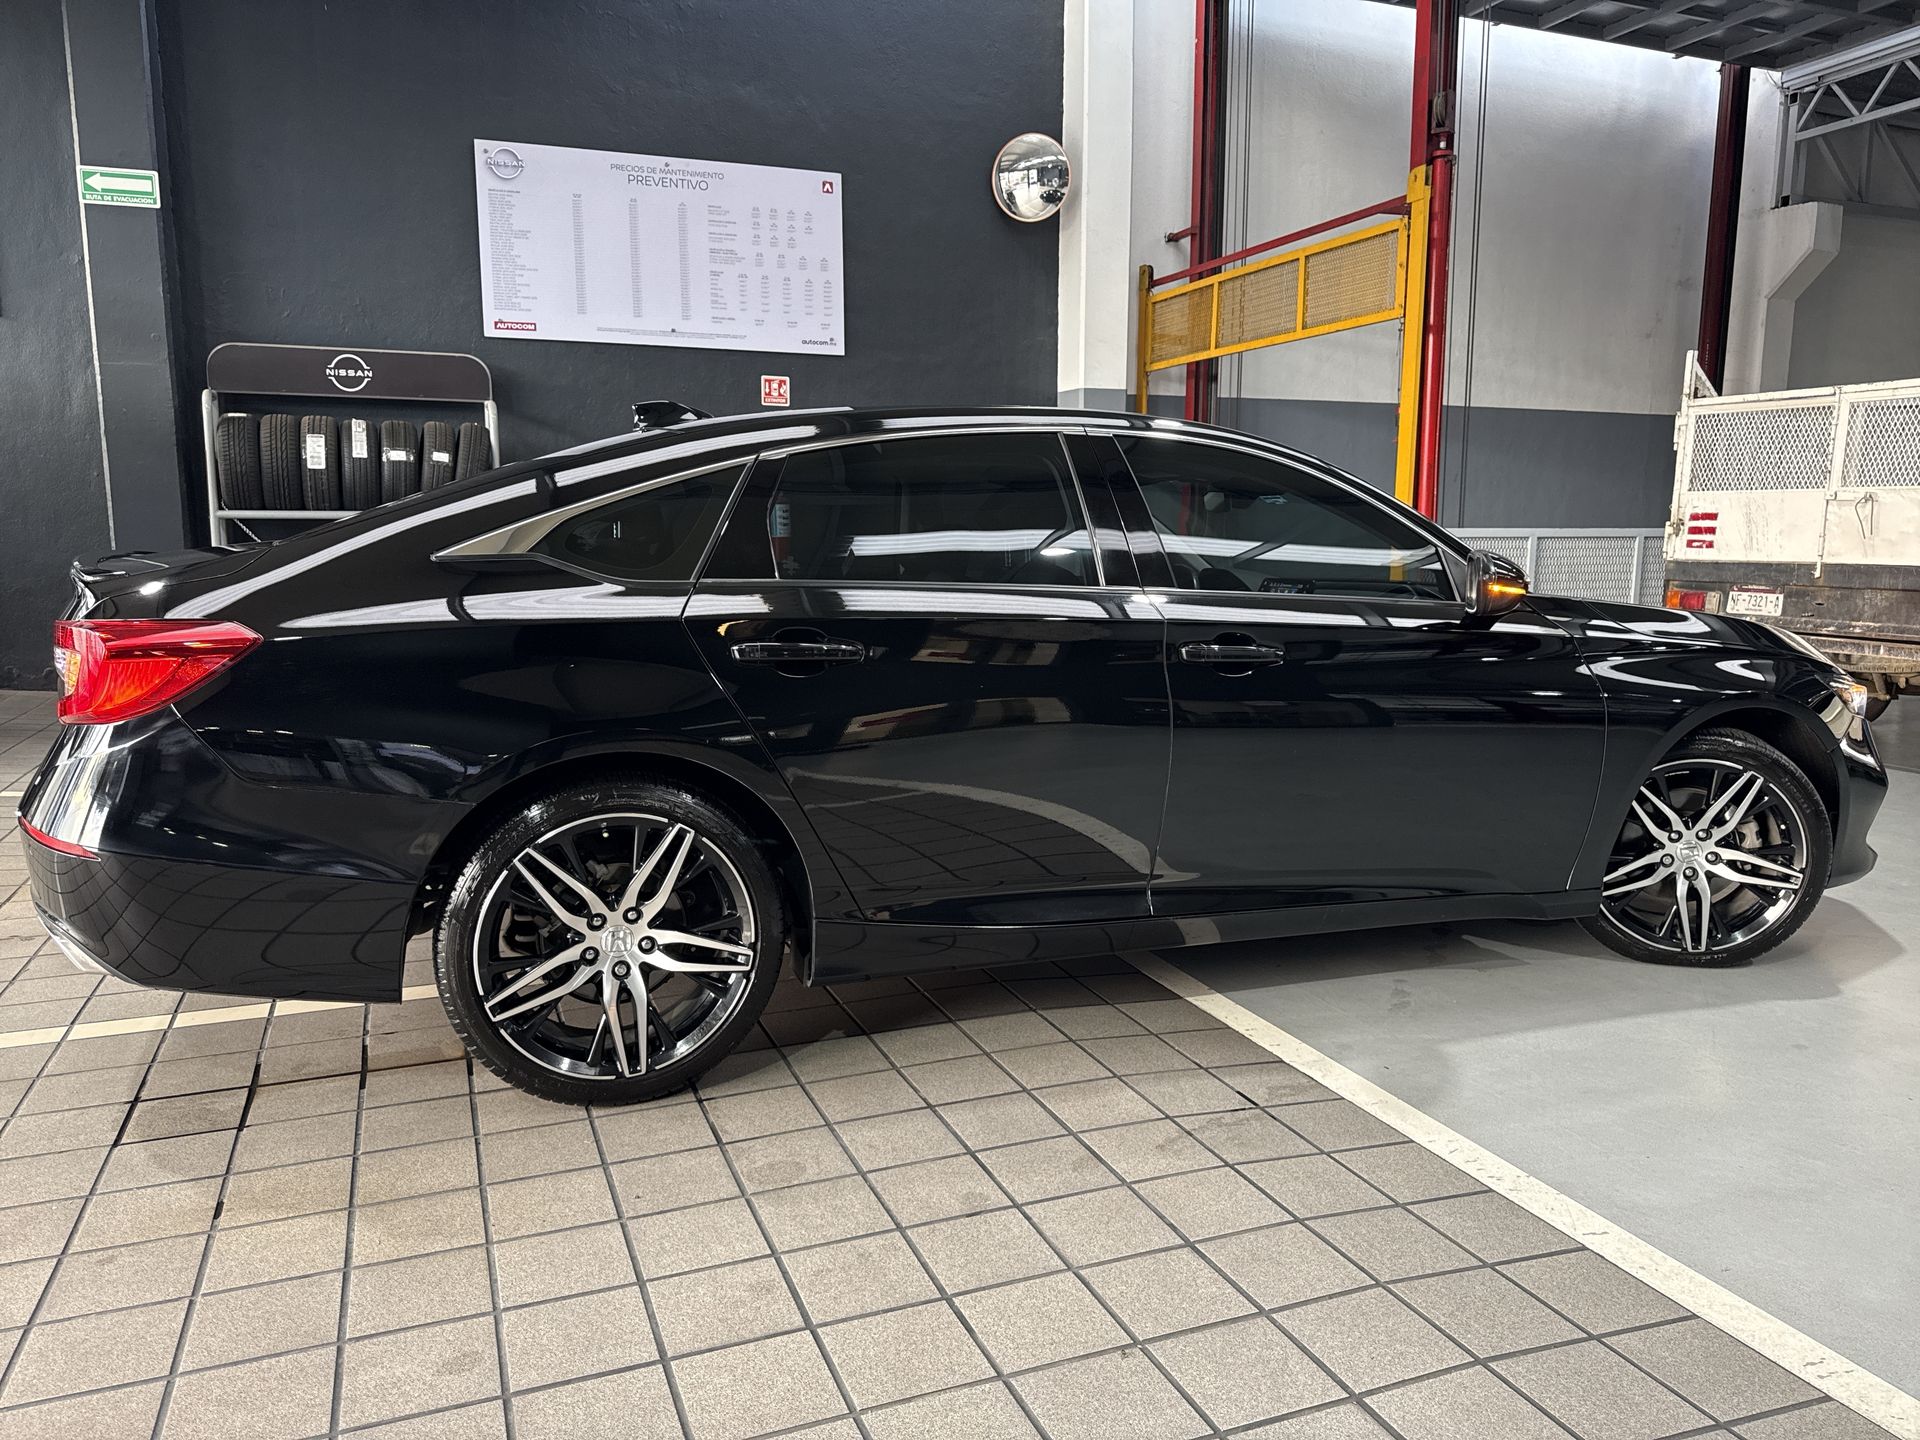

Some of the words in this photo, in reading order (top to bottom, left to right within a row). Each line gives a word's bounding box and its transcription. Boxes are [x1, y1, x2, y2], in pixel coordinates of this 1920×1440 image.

[487, 158, 526, 169] NISSAN
[610, 163, 645, 174] PRECIOS
[646, 166, 658, 174] DE
[659, 167, 725, 180] MANTENIMIENTO
[627, 173, 709, 191] PREVENTIVO
[496, 322, 535, 330] AUTOCOM
[325, 368, 373, 378] NISSAN
